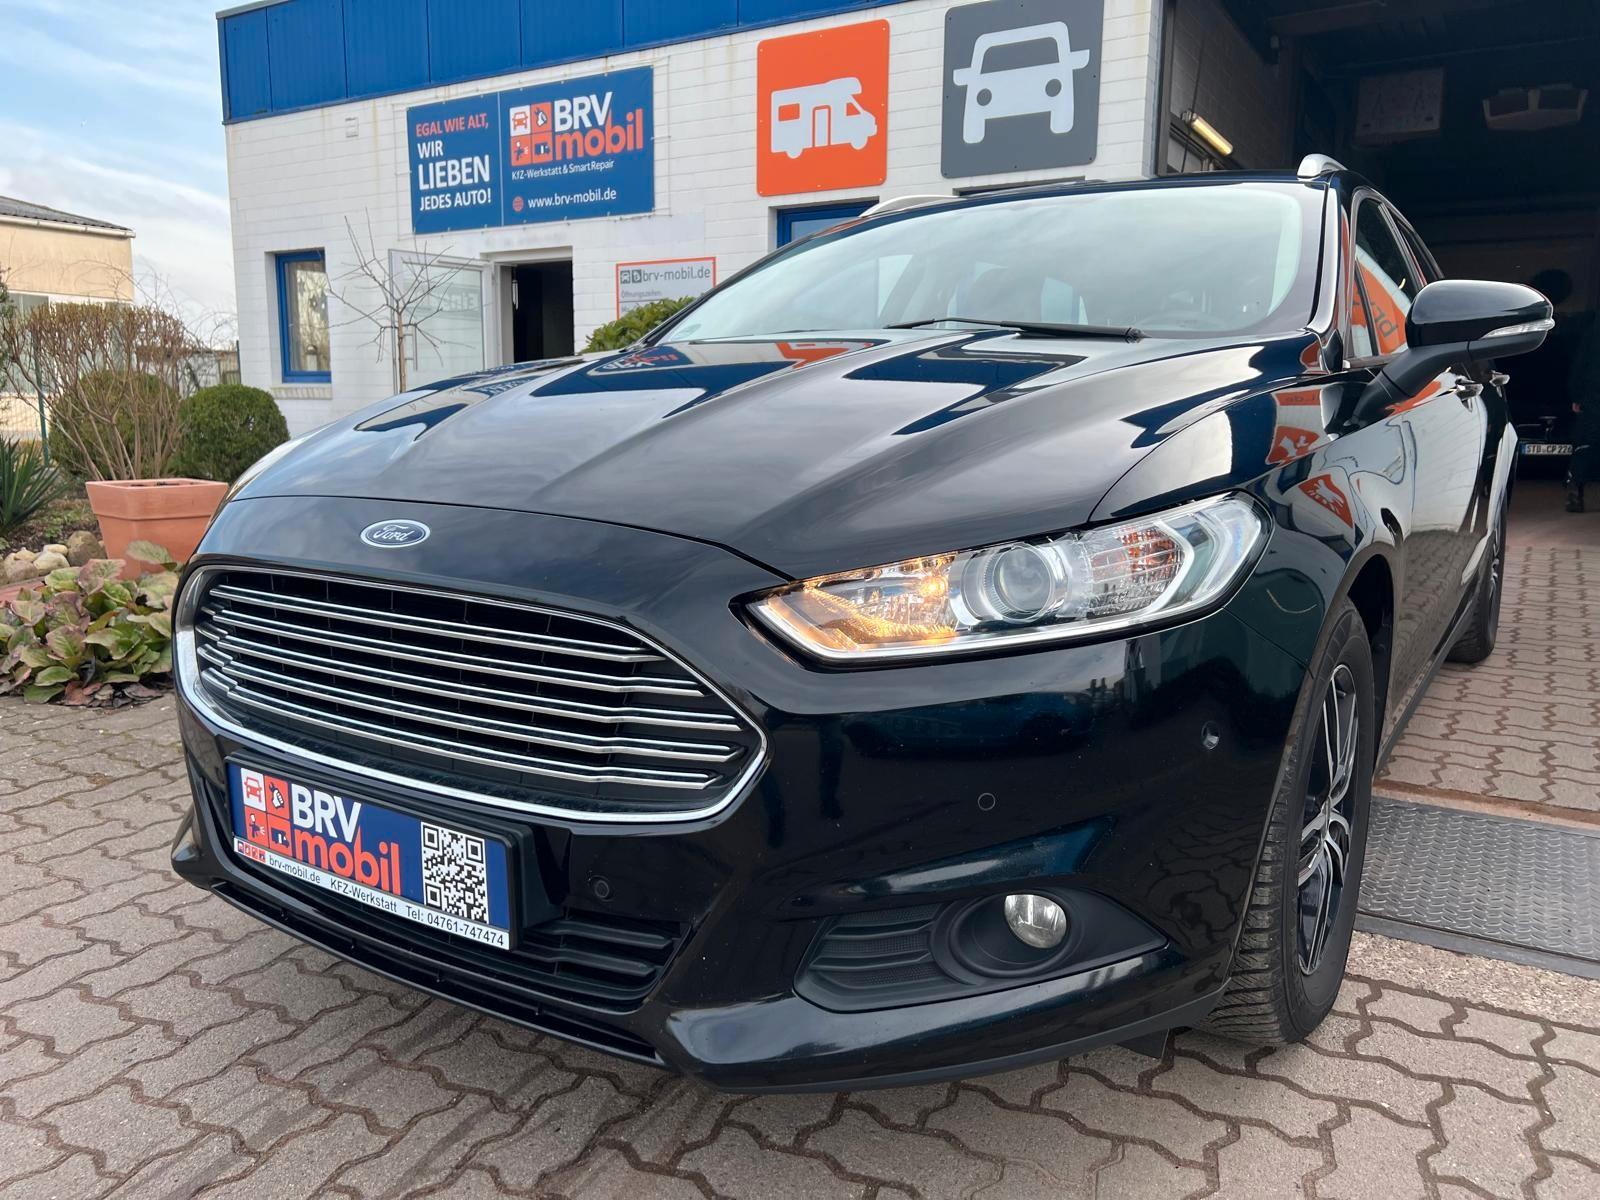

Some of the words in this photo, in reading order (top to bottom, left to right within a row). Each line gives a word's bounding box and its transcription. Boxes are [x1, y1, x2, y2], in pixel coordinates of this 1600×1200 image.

[554, 91, 613, 132] BRV
[416, 121, 443, 137] EGAL
[444, 118, 466, 133] WIE
[467, 113, 489, 131] ALT,
[555, 108, 644, 160] mobil
[417, 140, 444, 159] WIR
[418, 154, 490, 190] LIEBEN
[563, 165, 568, 174] &
[419, 193, 452, 211] JEDES
[454, 189, 491, 207] AUTO!
[528, 187, 617, 208] www.brv-mobil.de
[643, 266, 711, 282] brv-mobil.de
[373, 524, 415, 541] Ford
[290, 783, 362, 843] BRV
[293, 824, 402, 896] mobil
[269, 854, 321, 884] brv-mobil.de
[330, 879, 398, 913] KFZ-Werkstatt
[405, 905, 425, 922] Tel:
[427, 912, 504, 947] 04761-747474
